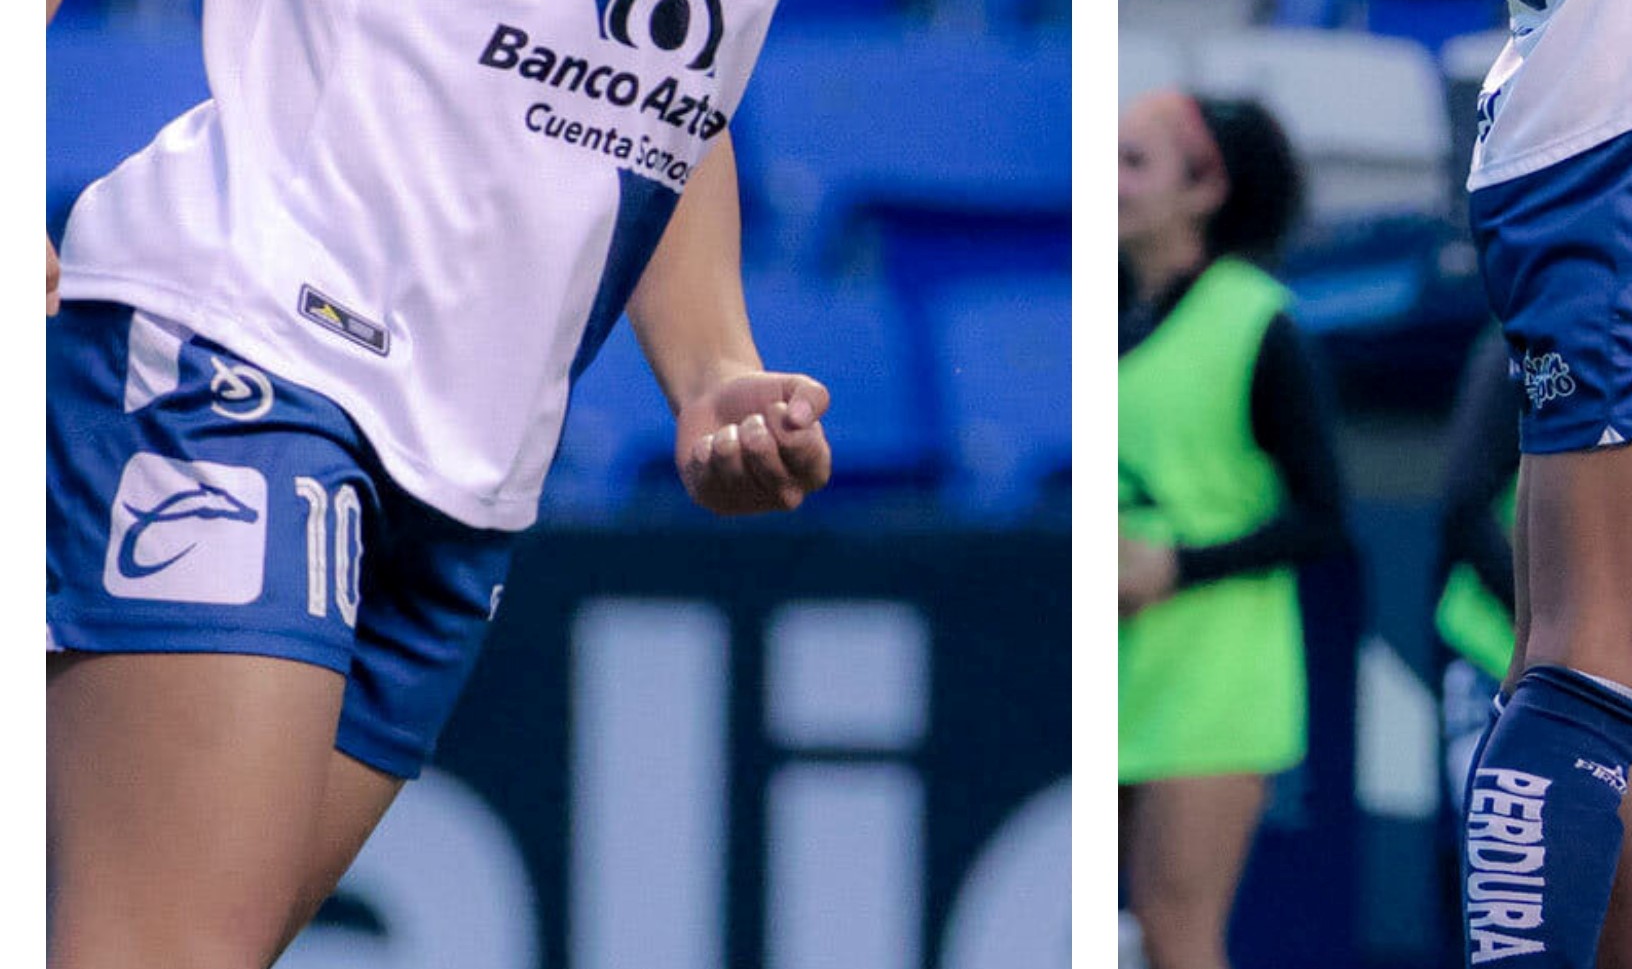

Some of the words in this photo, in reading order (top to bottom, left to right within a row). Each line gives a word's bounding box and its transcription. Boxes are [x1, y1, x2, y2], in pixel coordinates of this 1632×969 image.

[478, 23, 640, 107] Banco
[525, 103, 633, 160] Cuenta
[294, 476, 364, 629] 10
[1466, 767, 1552, 965] PERDURA
